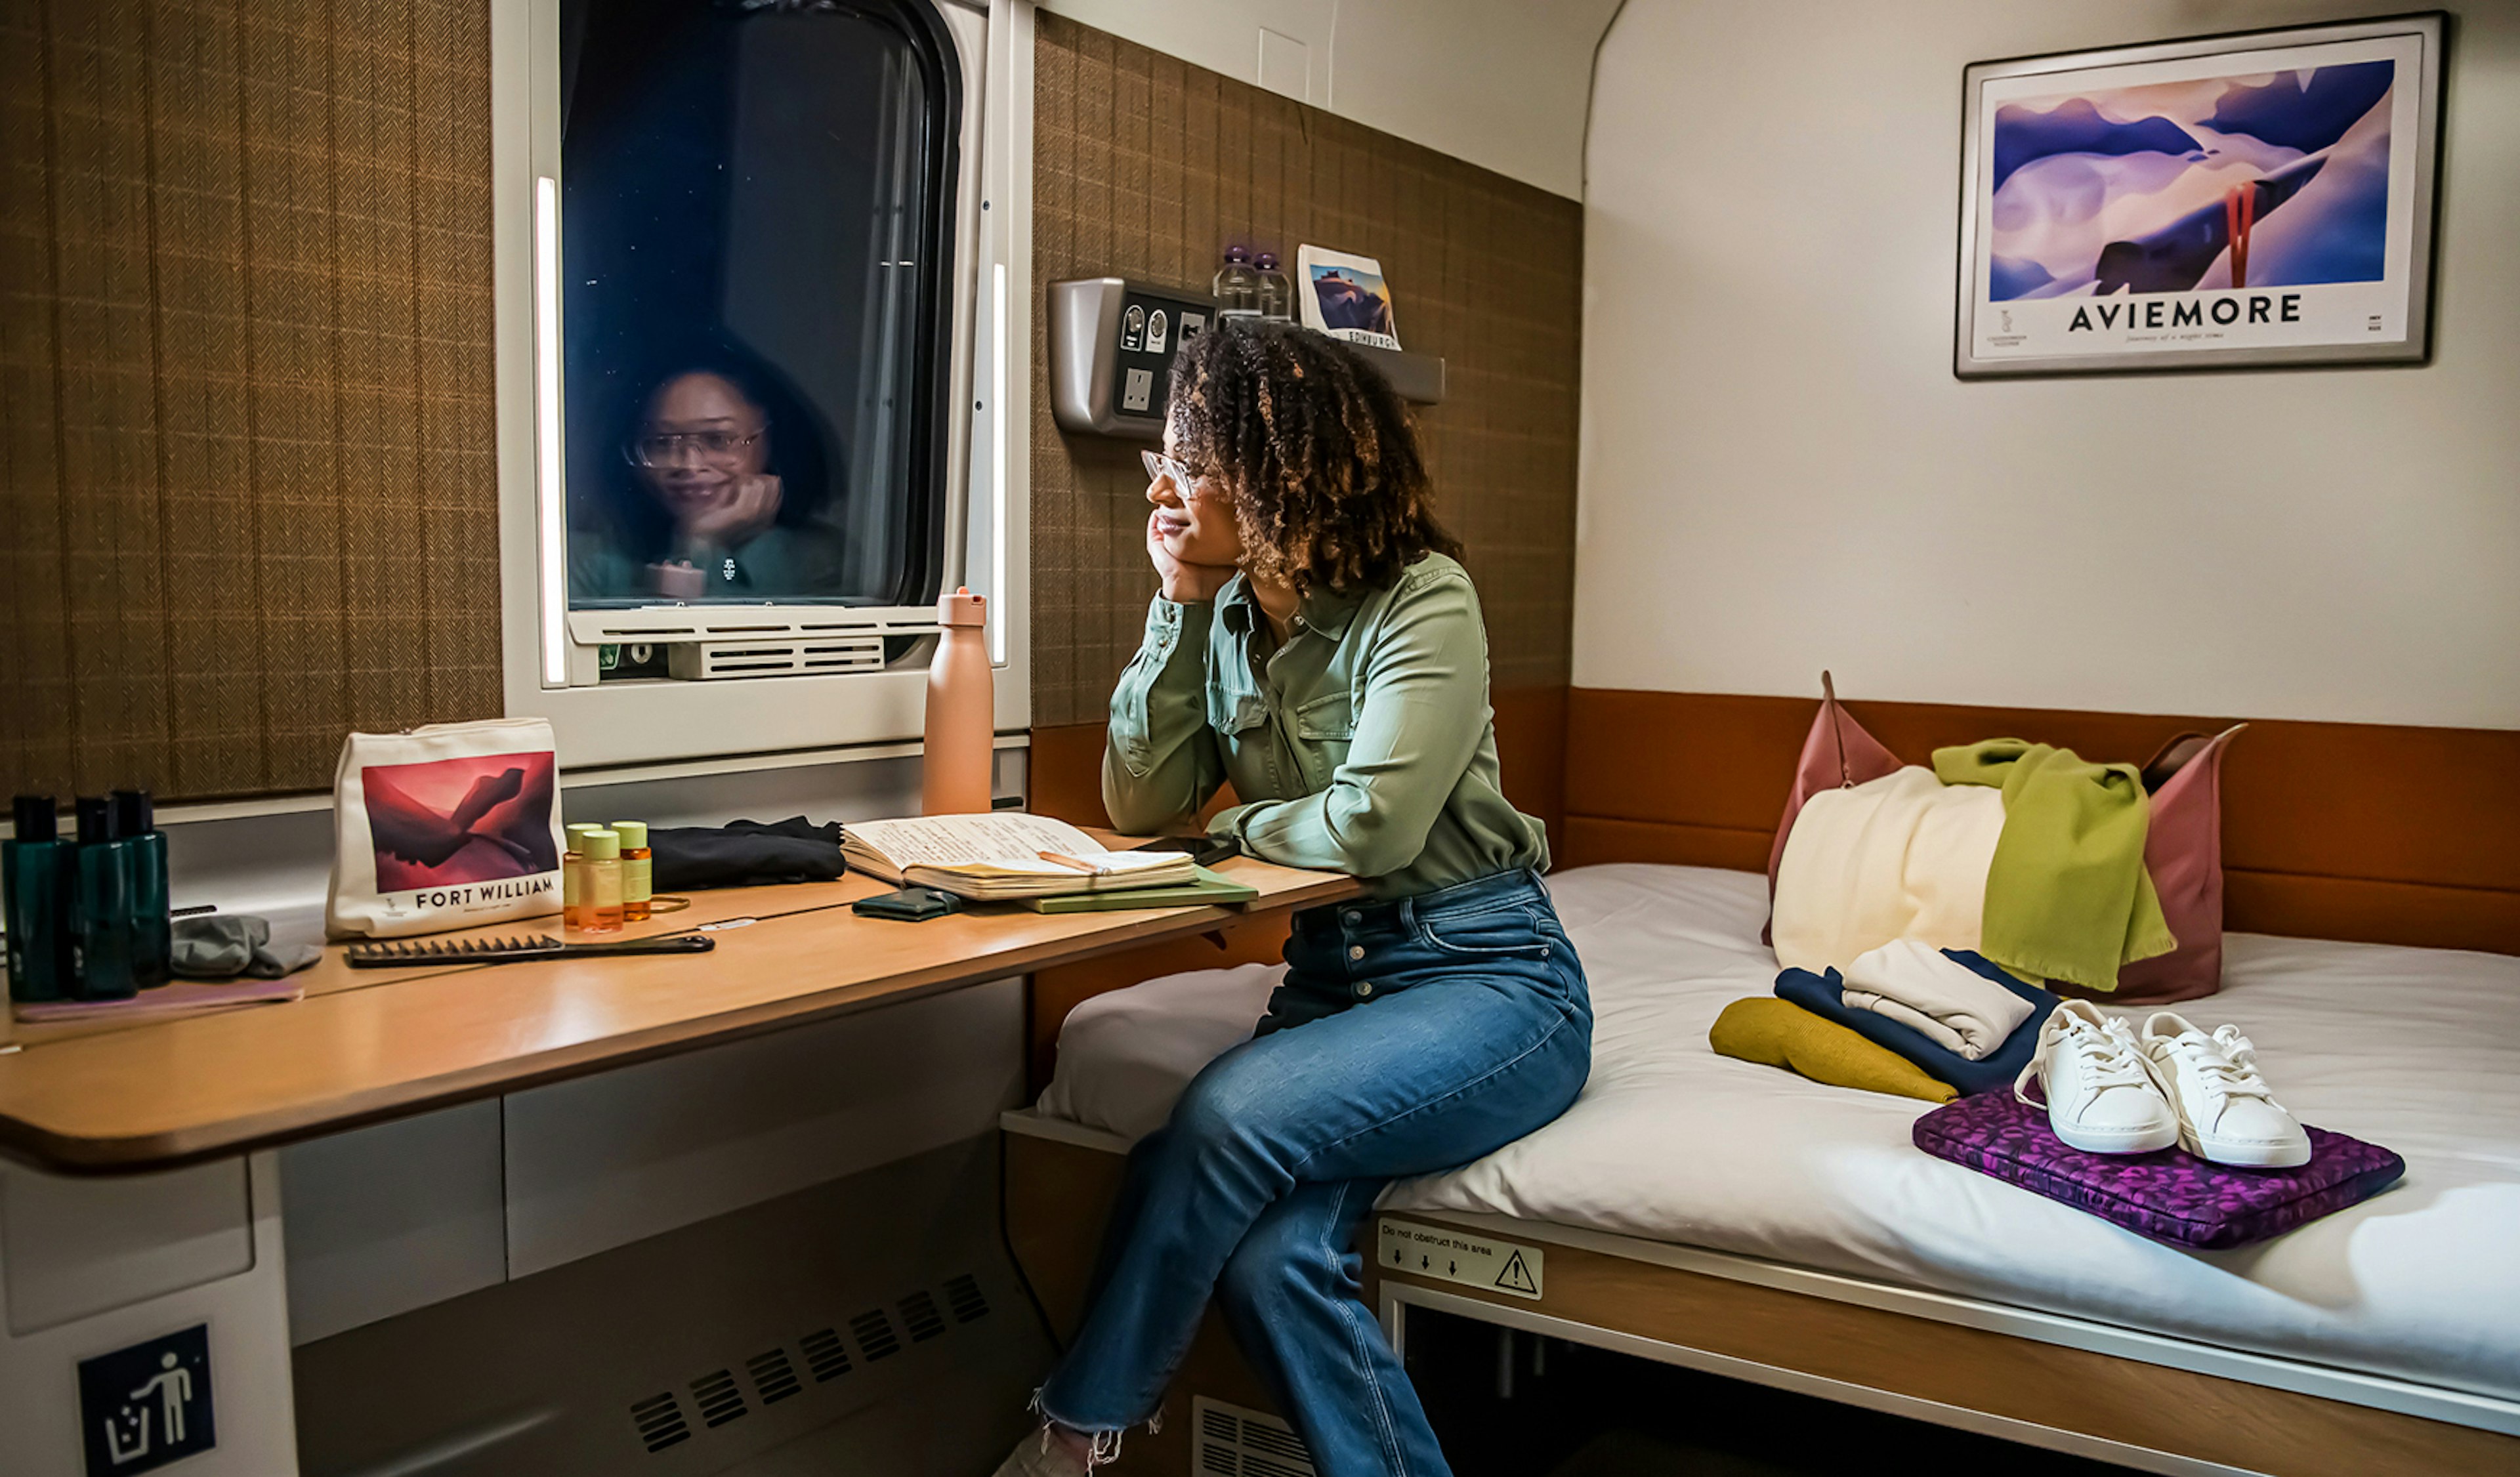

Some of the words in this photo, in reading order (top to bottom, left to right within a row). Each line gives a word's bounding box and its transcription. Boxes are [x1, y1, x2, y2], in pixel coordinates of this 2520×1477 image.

[2068, 294, 2301, 332] AVIEMORE
[415, 888, 472, 909] FORT
[480, 878, 554, 902] WILLIAM
[1382, 1224, 1395, 1236] Do
[1397, 1228, 1412, 1239] not
[1414, 1232, 1450, 1248] obstruct
[1452, 1239, 1469, 1252] this
[1471, 1243, 1492, 1256] area
